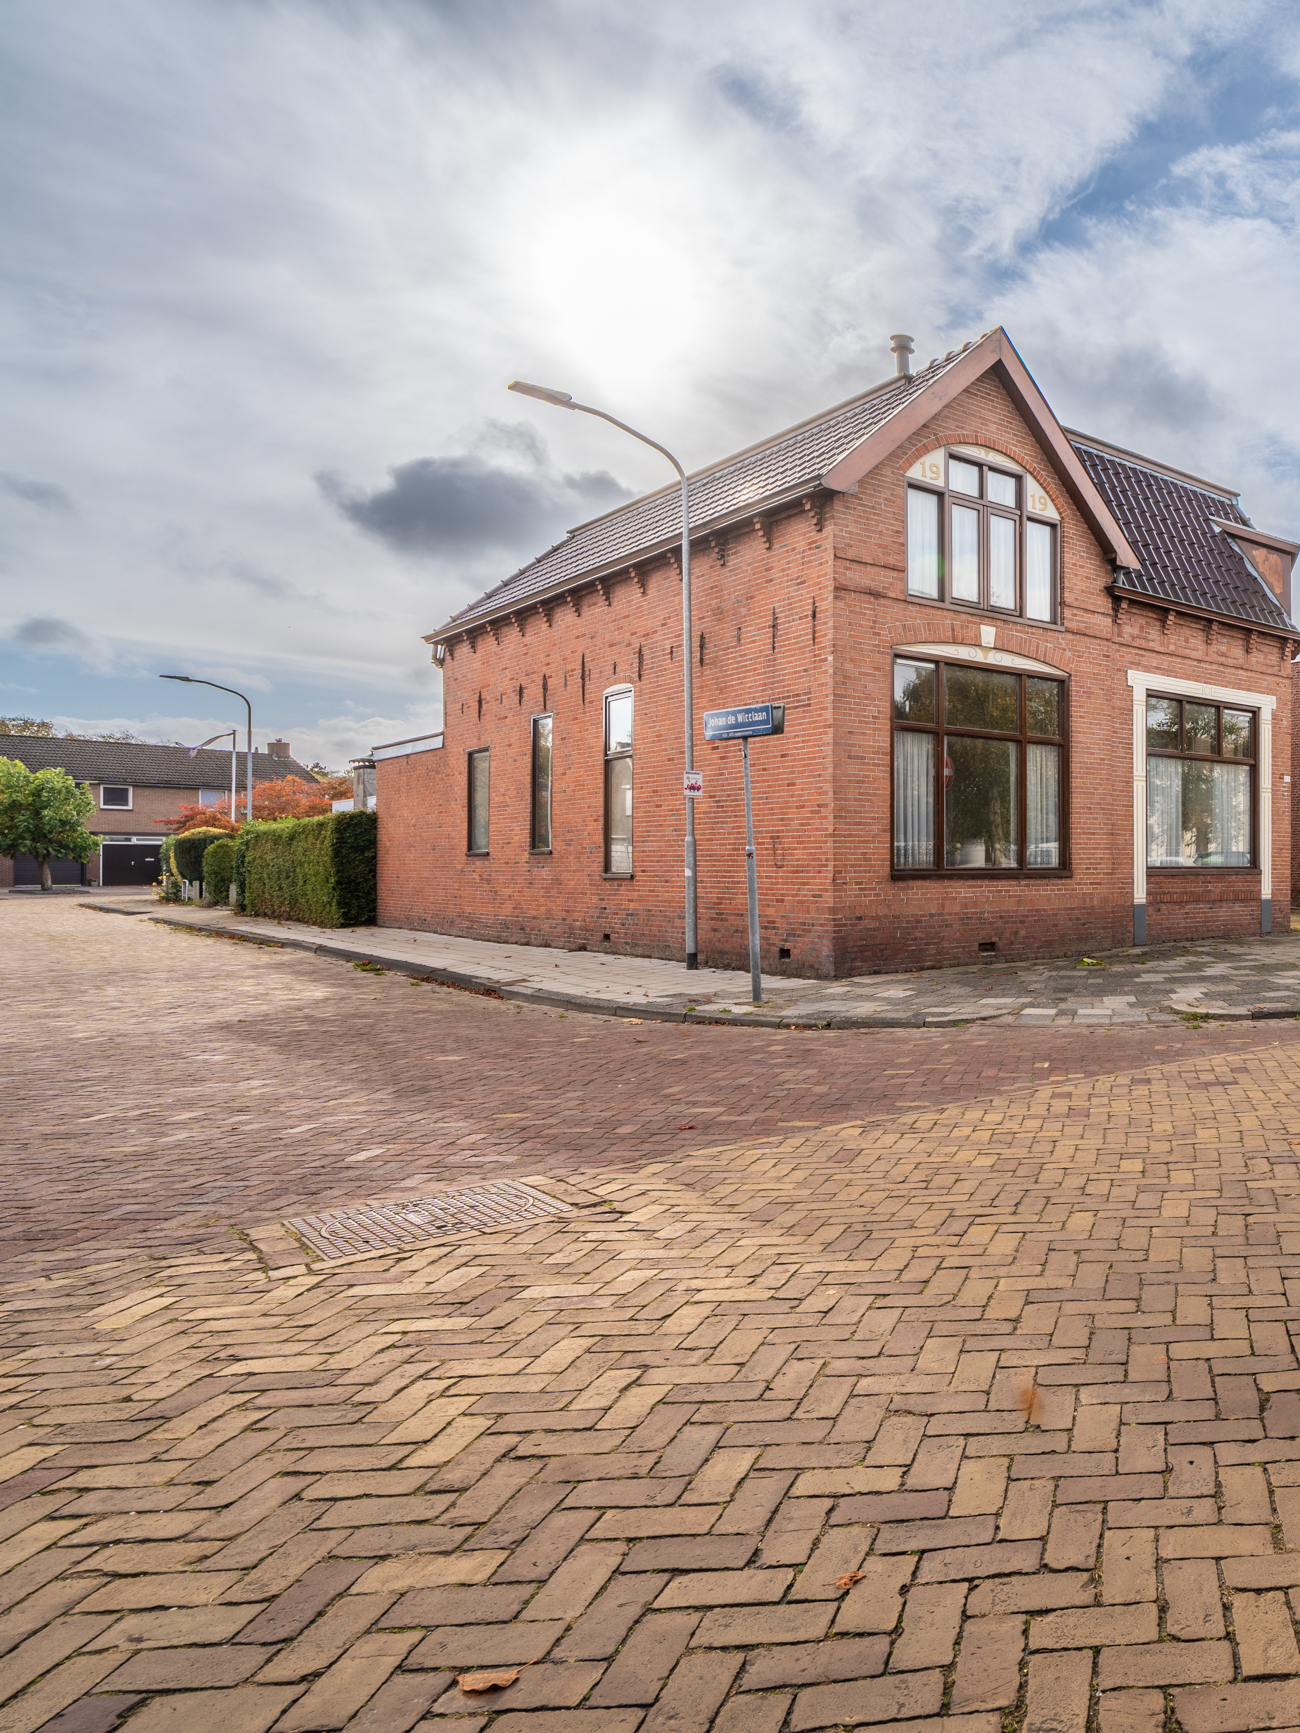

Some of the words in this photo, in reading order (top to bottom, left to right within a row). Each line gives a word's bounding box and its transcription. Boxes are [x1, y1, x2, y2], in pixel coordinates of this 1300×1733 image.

[919, 460, 941, 480] 19
[1030, 493, 1048, 512] 19
[708, 716, 727, 727] Johan
[727, 714, 736, 724] de
[737, 711, 767, 723] Wittlaan
